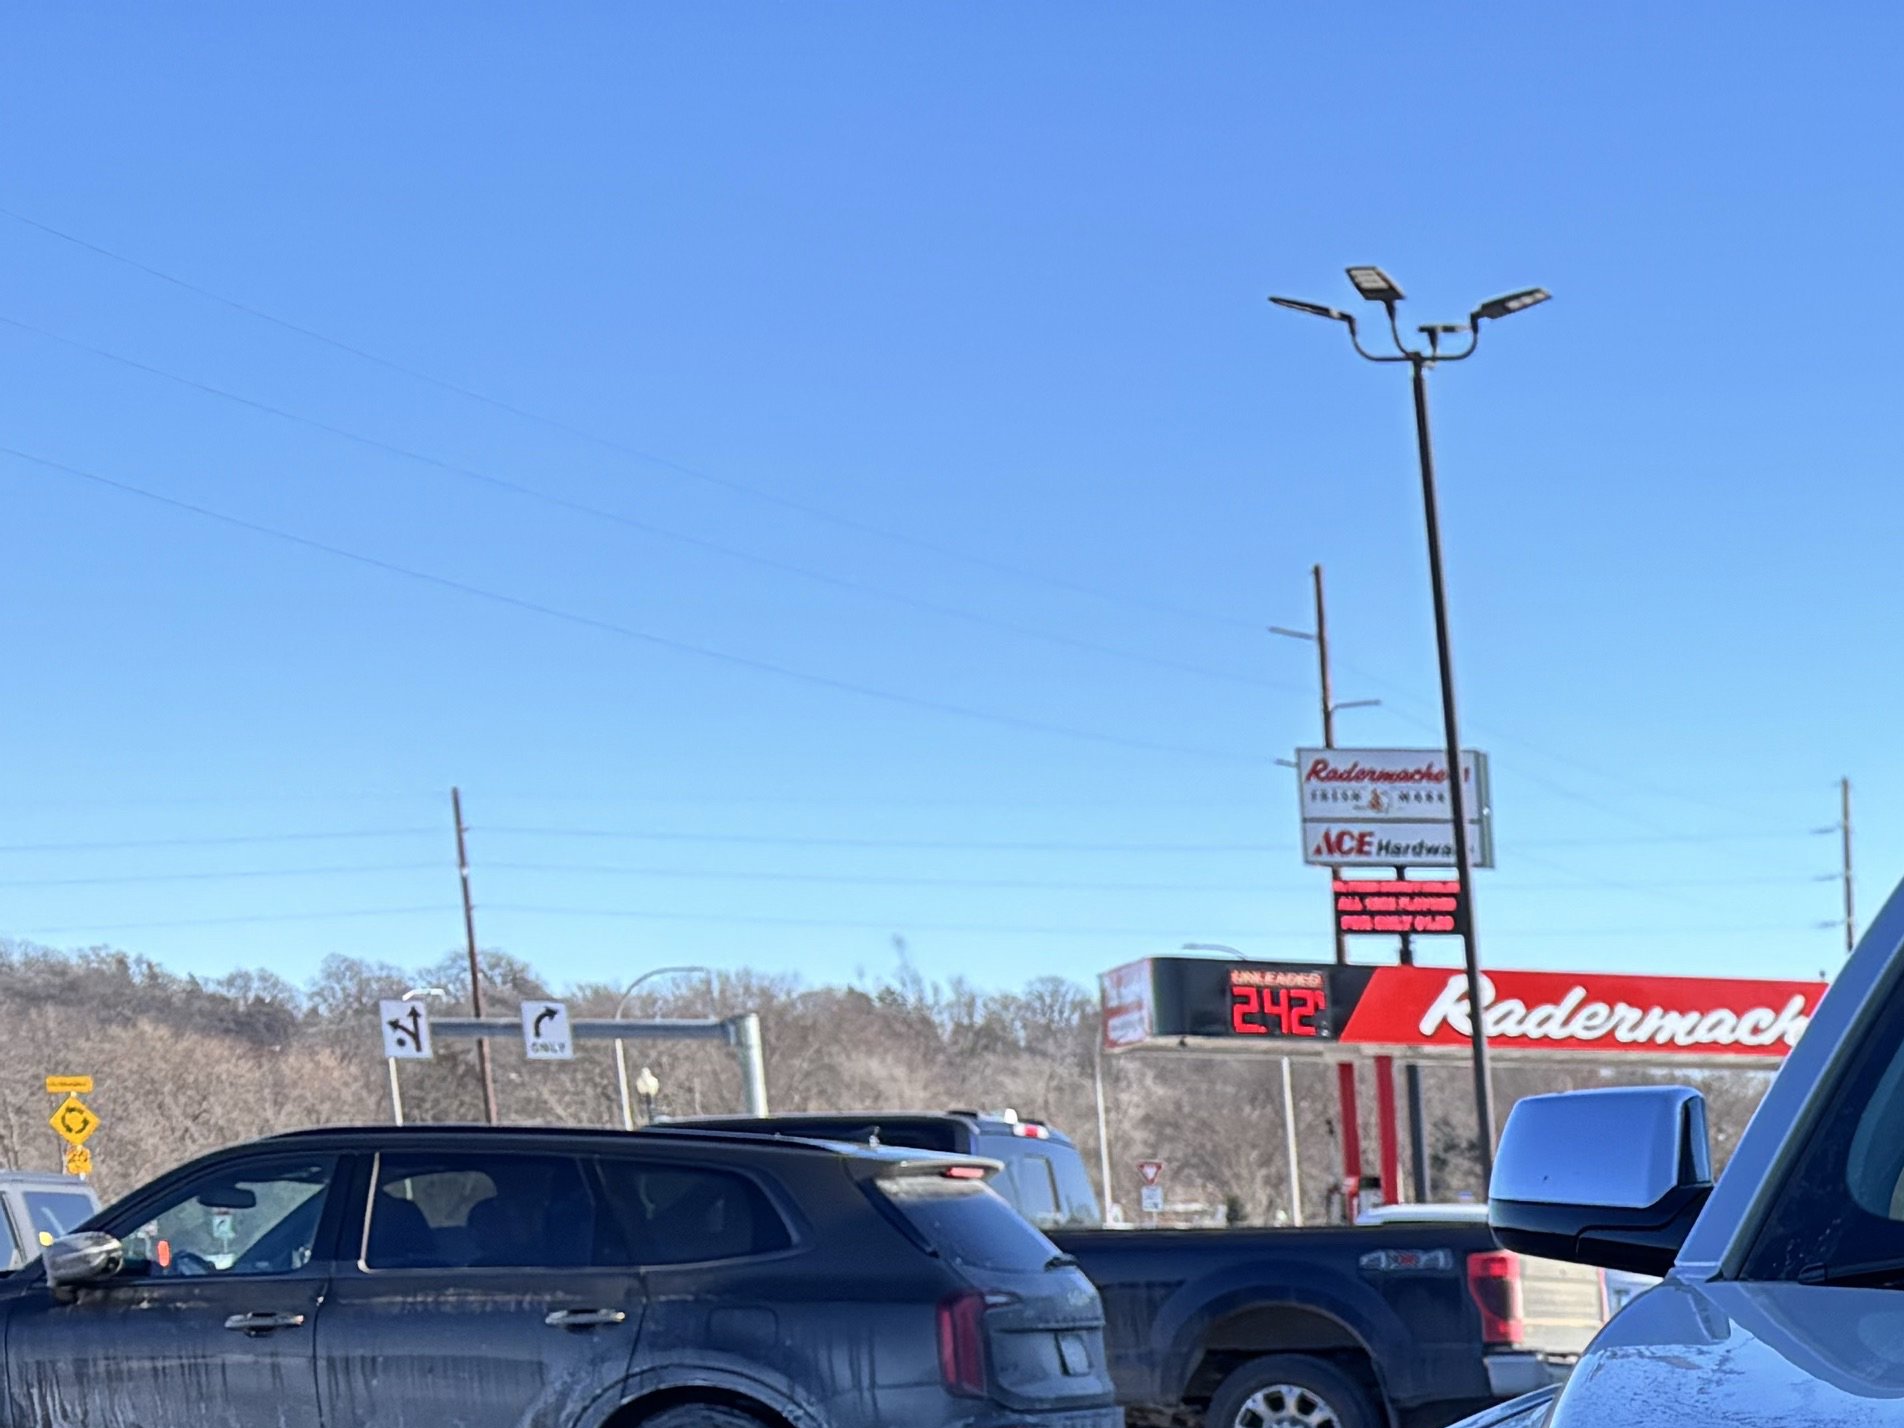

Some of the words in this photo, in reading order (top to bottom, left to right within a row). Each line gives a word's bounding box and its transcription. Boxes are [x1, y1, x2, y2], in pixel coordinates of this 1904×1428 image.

[1313, 826, 1374, 858] ACE
[1375, 837, 1474, 858] Hardwa
[1231, 969, 1323, 988] UNLEADED
[531, 1041, 566, 1054] ONLY
